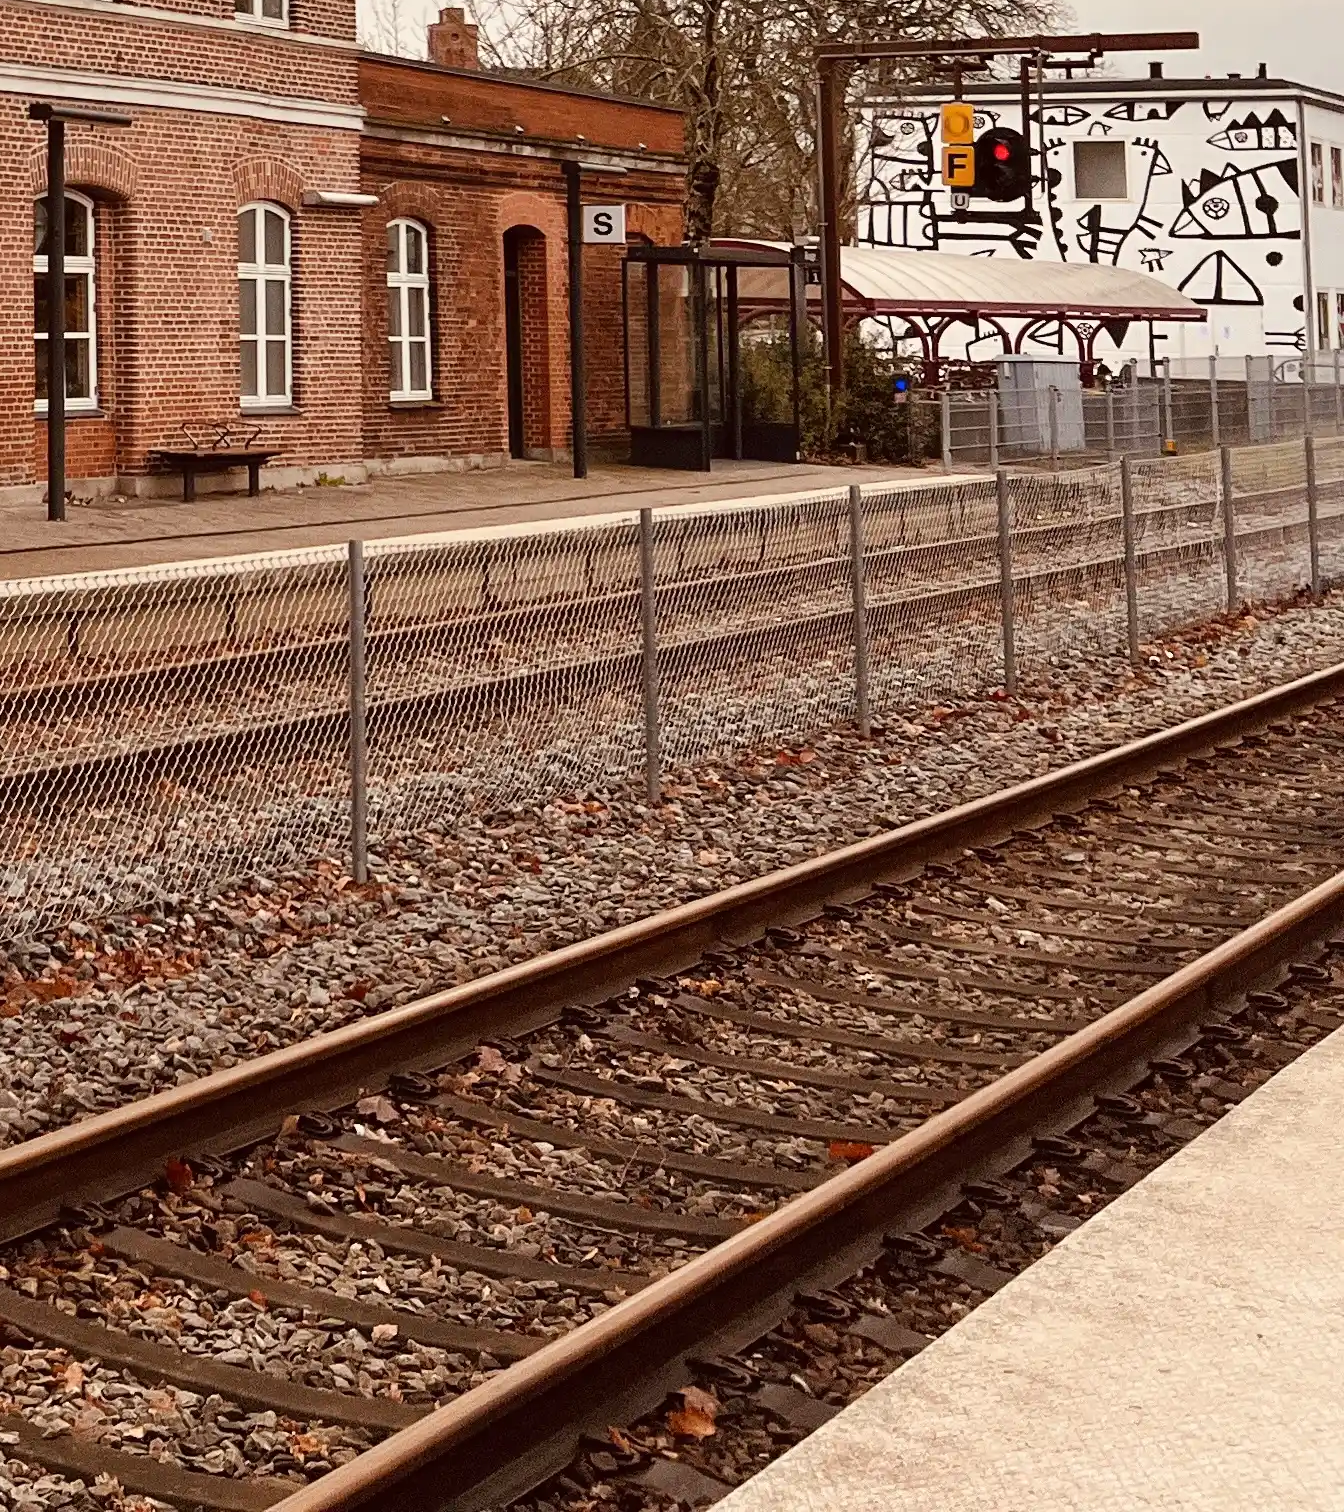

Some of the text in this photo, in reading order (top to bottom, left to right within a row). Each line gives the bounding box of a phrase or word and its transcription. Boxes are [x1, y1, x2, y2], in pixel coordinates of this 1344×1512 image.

[947, 153, 968, 179] F
[954, 194, 966, 207] U
[593, 212, 613, 236] S
